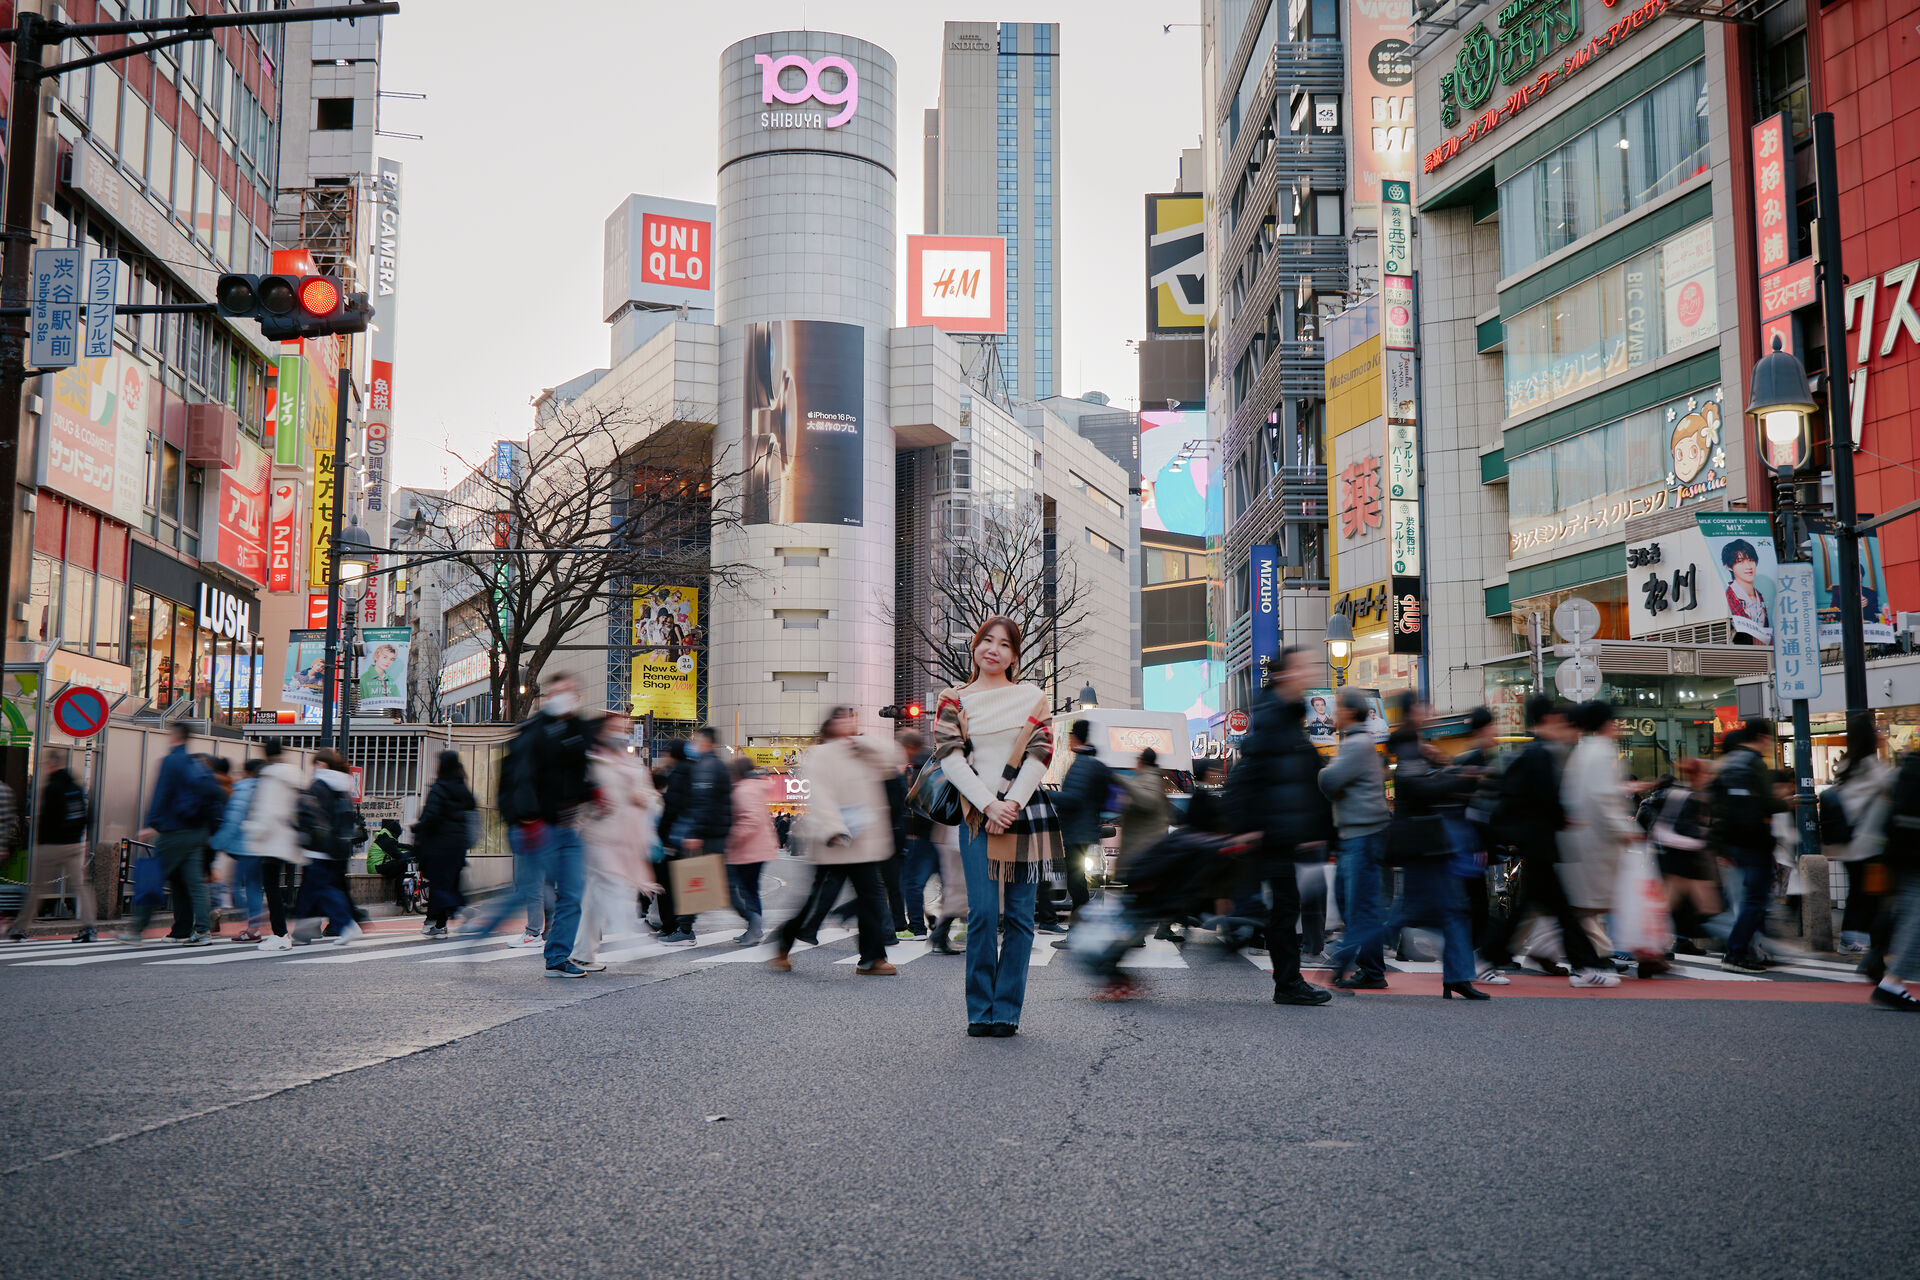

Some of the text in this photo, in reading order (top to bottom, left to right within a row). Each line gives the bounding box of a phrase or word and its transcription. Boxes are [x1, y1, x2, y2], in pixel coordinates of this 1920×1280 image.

[949, 41, 991, 51] INDIGO
[1377, 52, 1411, 62] 10:
[1499, 0, 1578, 86] 西村
[755, 54, 858, 128] 109
[761, 113, 821, 128] SHIBUYA
[1760, 128, 1783, 265] お好み焼
[379, 208, 397, 297] CAMERA
[650, 222, 699, 253] UNI
[649, 251, 703, 281] QLO
[933, 268, 981, 299] H&M
[36, 273, 51, 345] Shibuya Sta.
[51, 257, 74, 357] 渋谷駅前
[90, 262, 112, 355] スクランブル式
[1329, 360, 1371, 390] Matsumoto
[52, 411, 74, 437] DRUG
[74, 424, 81, 439] &
[280, 391, 296, 426] レイク
[813, 411, 857, 422] iPhone 16 Pro
[806, 421, 858, 435] 大傑作のプロ。
[50, 437, 114, 492] サンドラッグ
[1403, 441, 1414, 478] フルーツ
[368, 456, 384, 513] 調剤薬局
[1341, 456, 1382, 540] 薬
[1669, 476, 1727, 509] Jasmine
[228, 486, 259, 537] アコム
[272, 525, 291, 569] アコム
[1394, 521, 1405, 559] フルーツ
[1405, 516, 1416, 556] 渋谷西村
[237, 545, 248, 568] 3F
[1626, 543, 1661, 569] うなぎ
[274, 574, 287, 583] 3F
[1260, 559, 1273, 614] MIZUHO
[1642, 563, 1698, 616] 松川
[200, 582, 250, 643] LUSH
[1399, 594, 1420, 634] HUB
[1778, 574, 1801, 678] 文化村通り
[643, 664, 678, 673] New &
[643, 672, 688, 682] Renewal
[643, 679, 693, 691] Shop Now
[1782, 680, 1805, 691] 方面
[784, 778, 811, 800] 109
